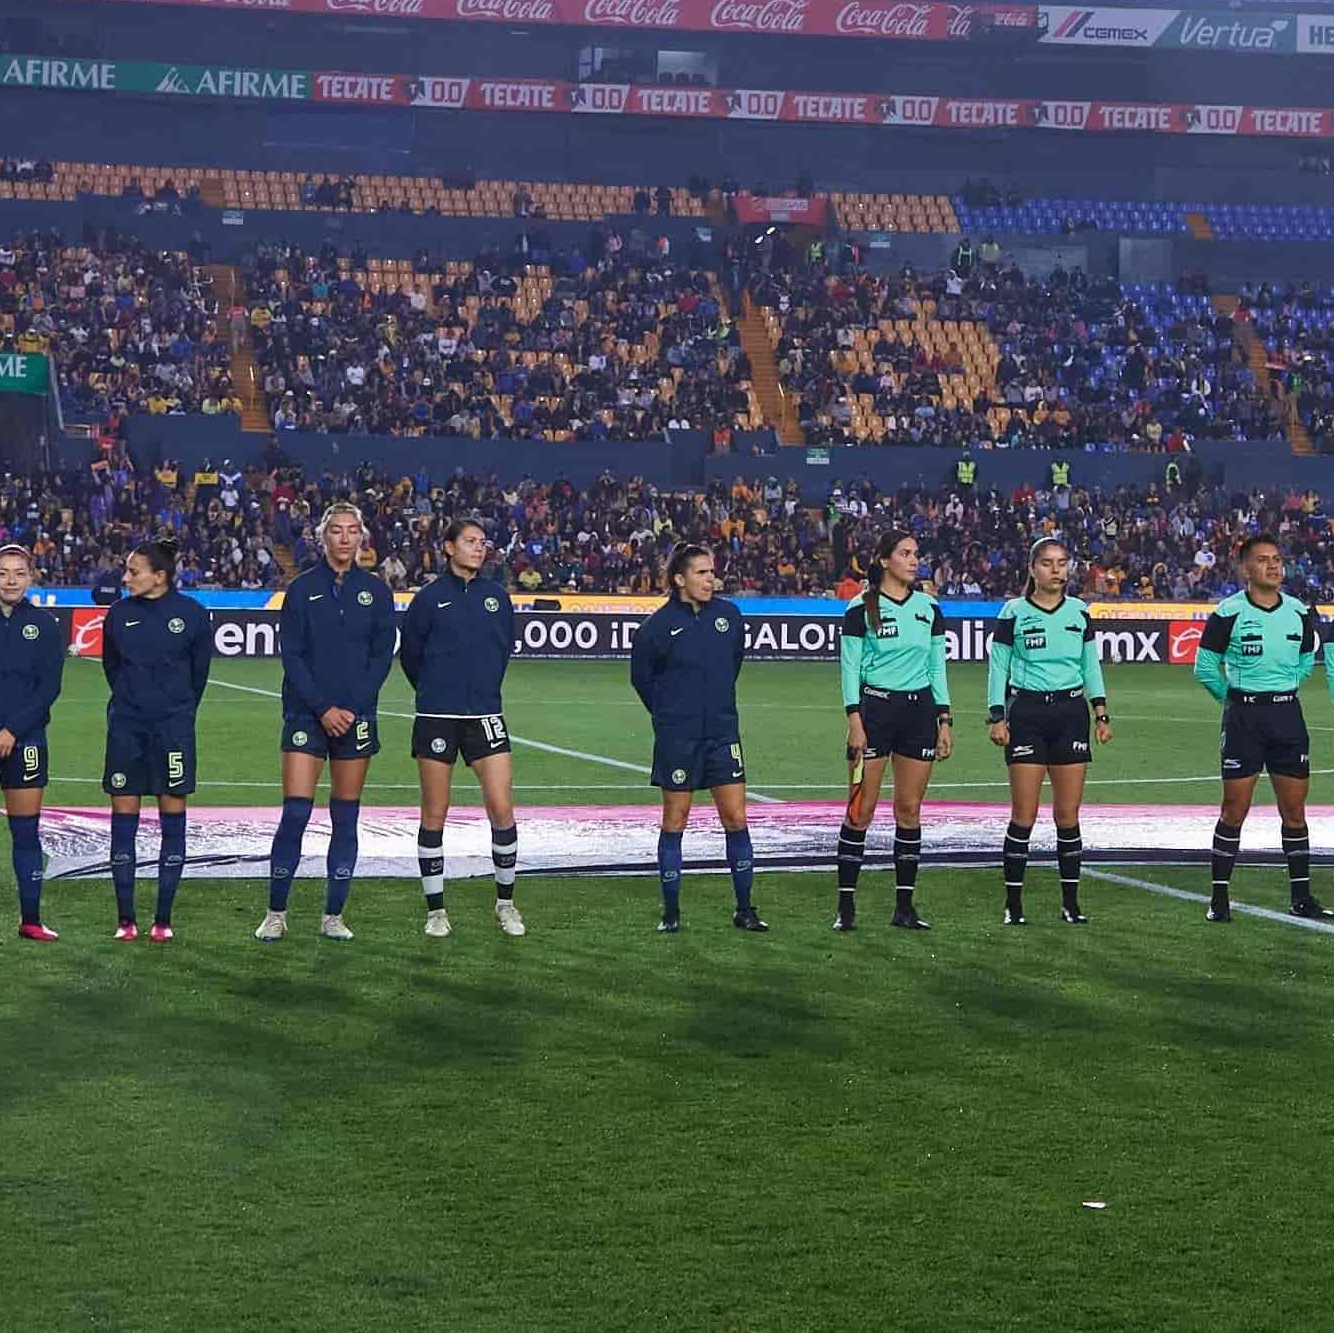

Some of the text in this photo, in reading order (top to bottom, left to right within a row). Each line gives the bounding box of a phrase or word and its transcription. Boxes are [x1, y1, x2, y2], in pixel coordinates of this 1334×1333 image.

[1084, 27, 1147, 40] CEMEX
[1180, 17, 1274, 49] Vertua
[3, 58, 116, 90] AFIRME
[197, 68, 306, 99] AFIRME
[317, 75, 395, 100] TECATE
[480, 82, 556, 107] TECATE
[638, 89, 711, 114] TECATE
[794, 94, 865, 120] TECATE
[947, 101, 1019, 125] TECATE
[1099, 105, 1172, 129] TECATE
[1250, 110, 1322, 134] TECATE
[744, 622, 835, 651] ALO!
[480, 717, 507, 742] 12
[23, 745, 39, 772] 9
[168, 752, 184, 779] 5
